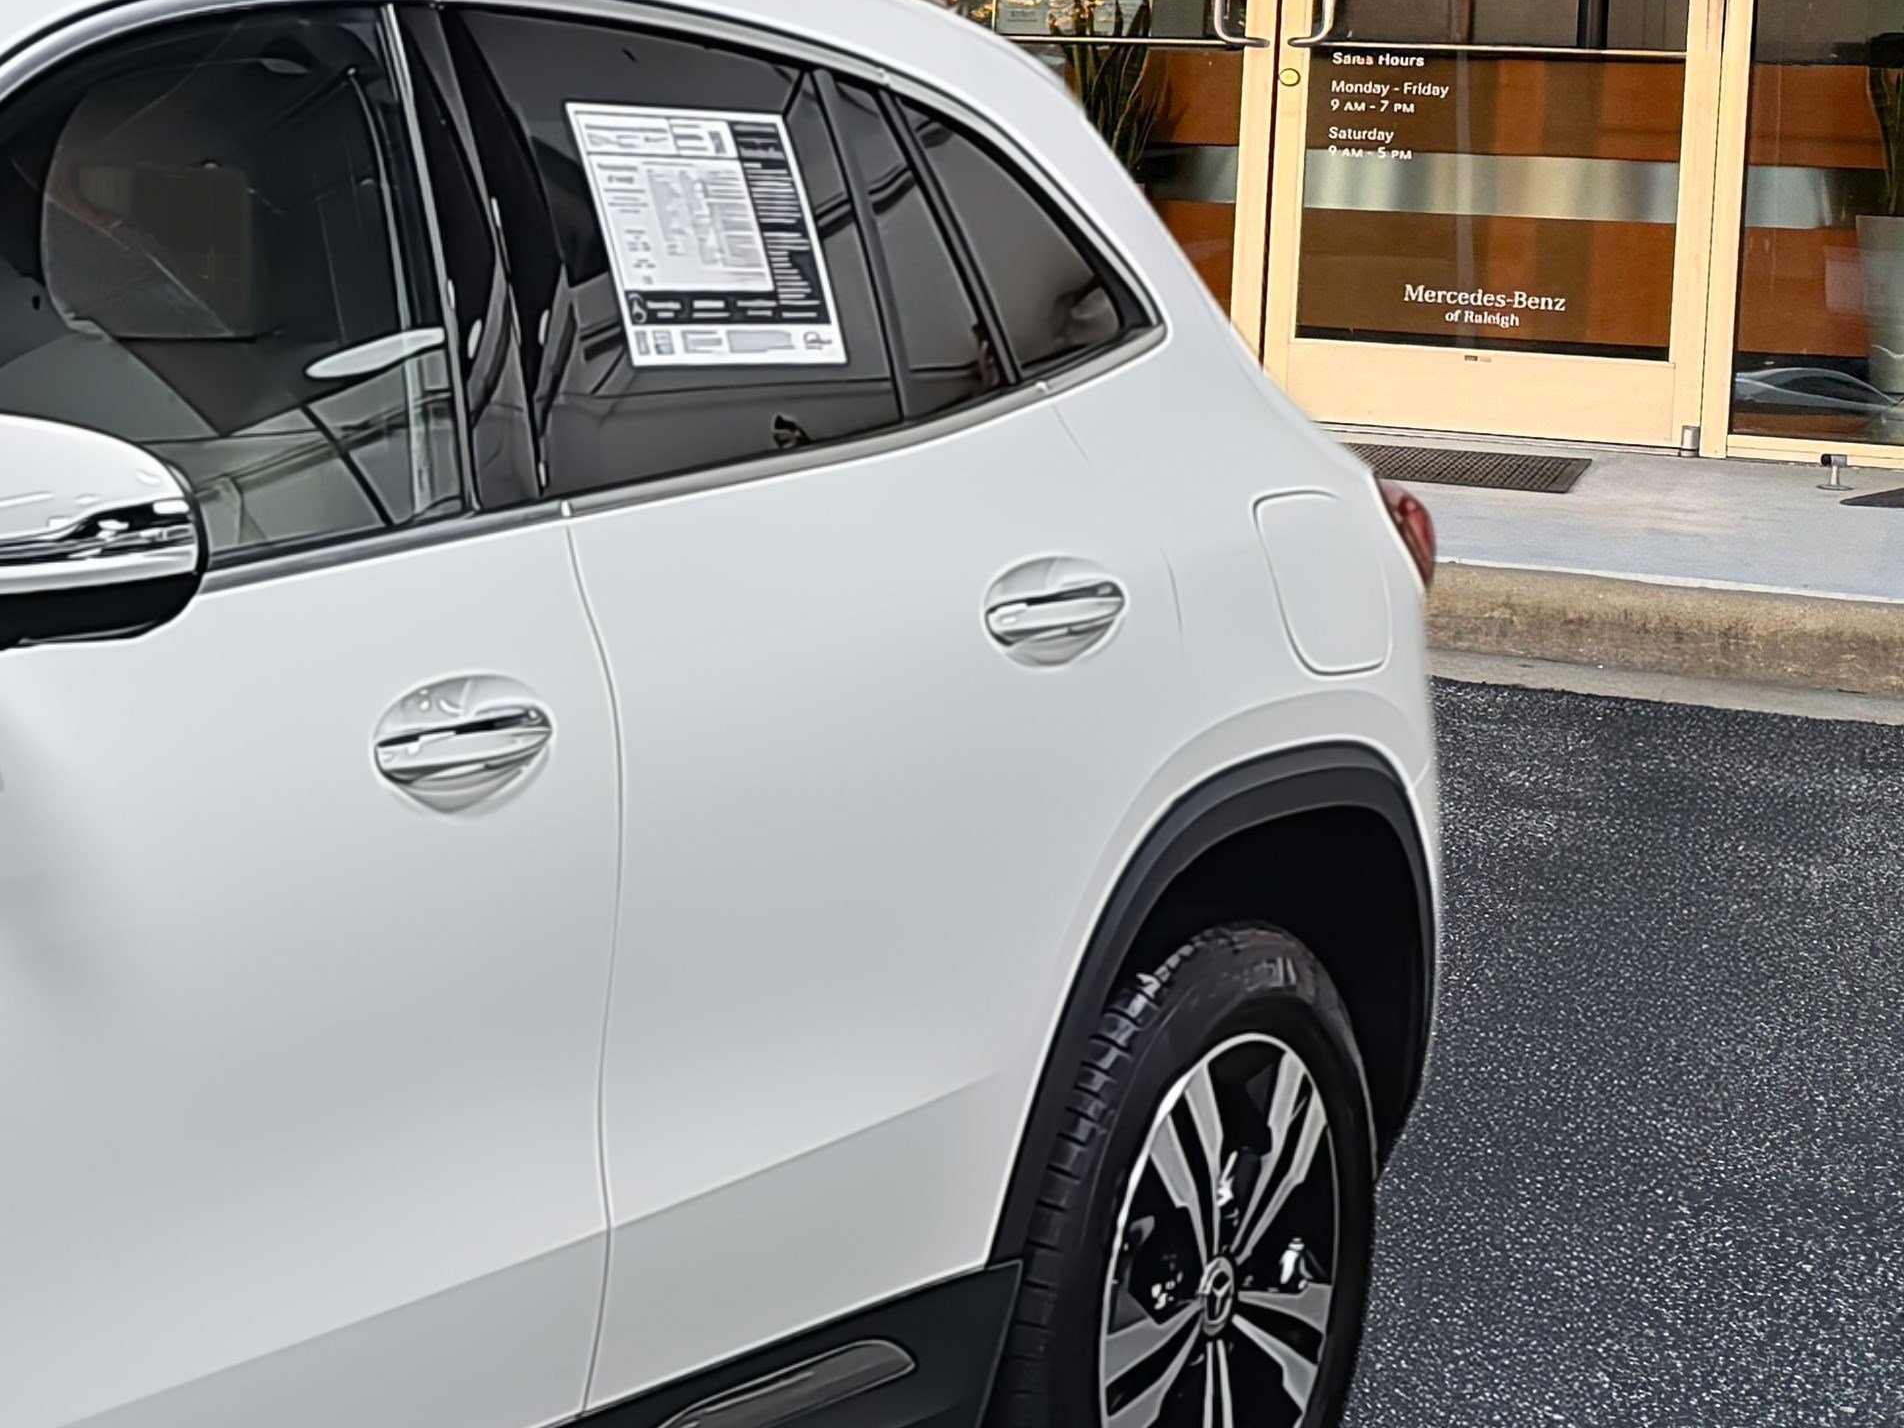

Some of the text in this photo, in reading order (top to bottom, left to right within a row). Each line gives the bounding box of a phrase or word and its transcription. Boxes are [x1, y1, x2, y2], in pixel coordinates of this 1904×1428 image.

[1378, 53, 1425, 67] Hours
[1331, 80, 1390, 97] Monday
[1403, 82, 1449, 99] Friday
[1330, 98, 1340, 112] 9
[1343, 102, 1366, 112] AM
[1379, 100, 1389, 113] 7
[1393, 103, 1415, 113] PM
[1328, 126, 1394, 144] Saturday
[1328, 145, 1338, 158] 9
[1341, 148, 1364, 158] AM
[1377, 147, 1387, 159] 5
[1391, 150, 1413, 160] PM
[1404, 283, 1566, 312] Mercedes-Benz
[1445, 309, 1520, 329] of Raleigh
